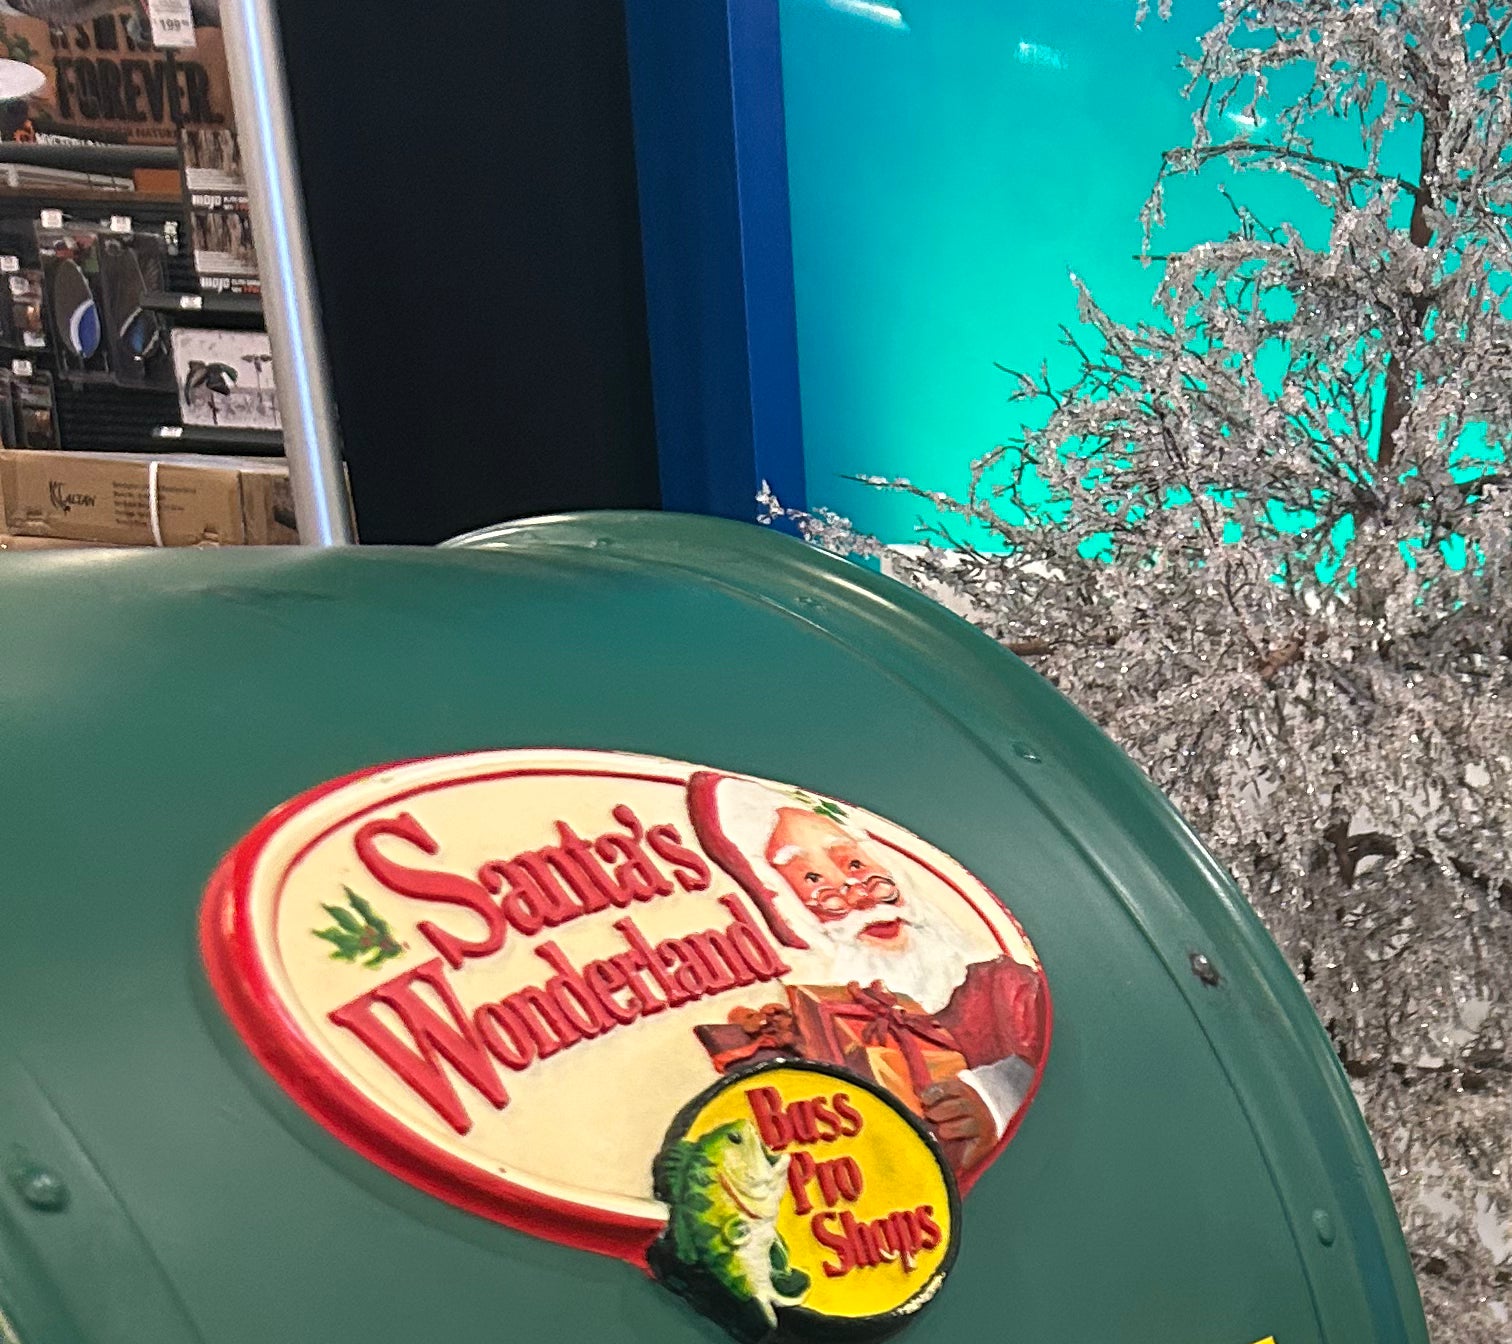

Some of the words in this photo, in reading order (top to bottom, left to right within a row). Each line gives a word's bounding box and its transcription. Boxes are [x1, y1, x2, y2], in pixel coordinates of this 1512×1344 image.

[54, 57, 225, 123] FOREVER
[354, 805, 708, 969] Santa's
[331, 894, 790, 1134] Wonderland
[745, 1086, 863, 1151] Bass
[787, 1151, 863, 1216] Pro
[811, 1205, 942, 1279] Shops
